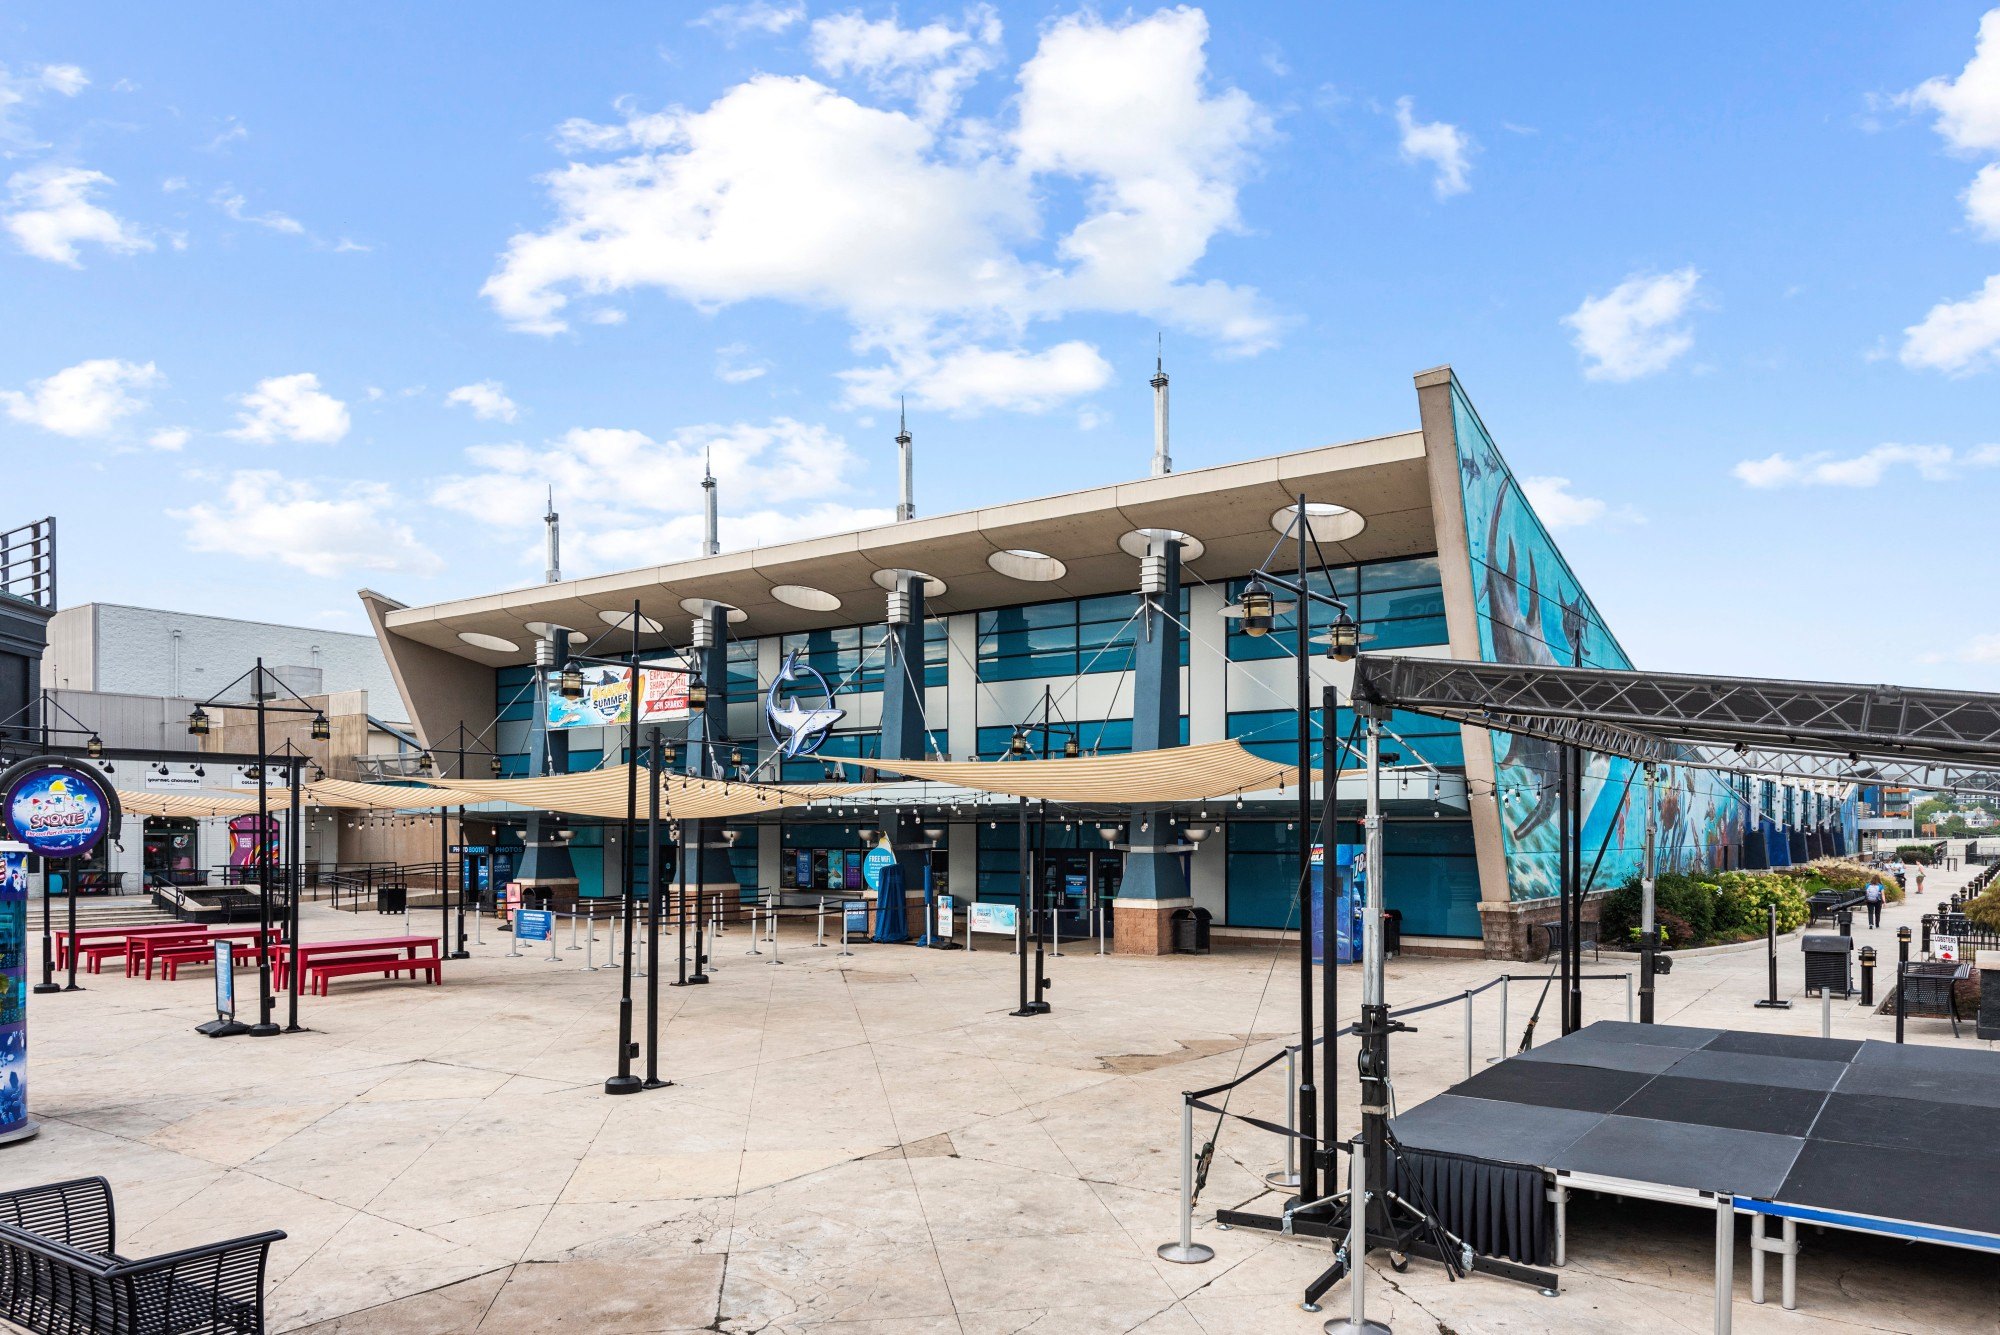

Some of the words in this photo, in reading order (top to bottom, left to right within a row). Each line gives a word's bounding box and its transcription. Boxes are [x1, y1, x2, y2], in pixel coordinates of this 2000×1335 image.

[593, 693, 628, 709] SUMMER
[31, 813, 84, 829] SNOWIE
[869, 855, 881, 863] FREE
[1934, 936, 1957, 944] LOBSTERS
